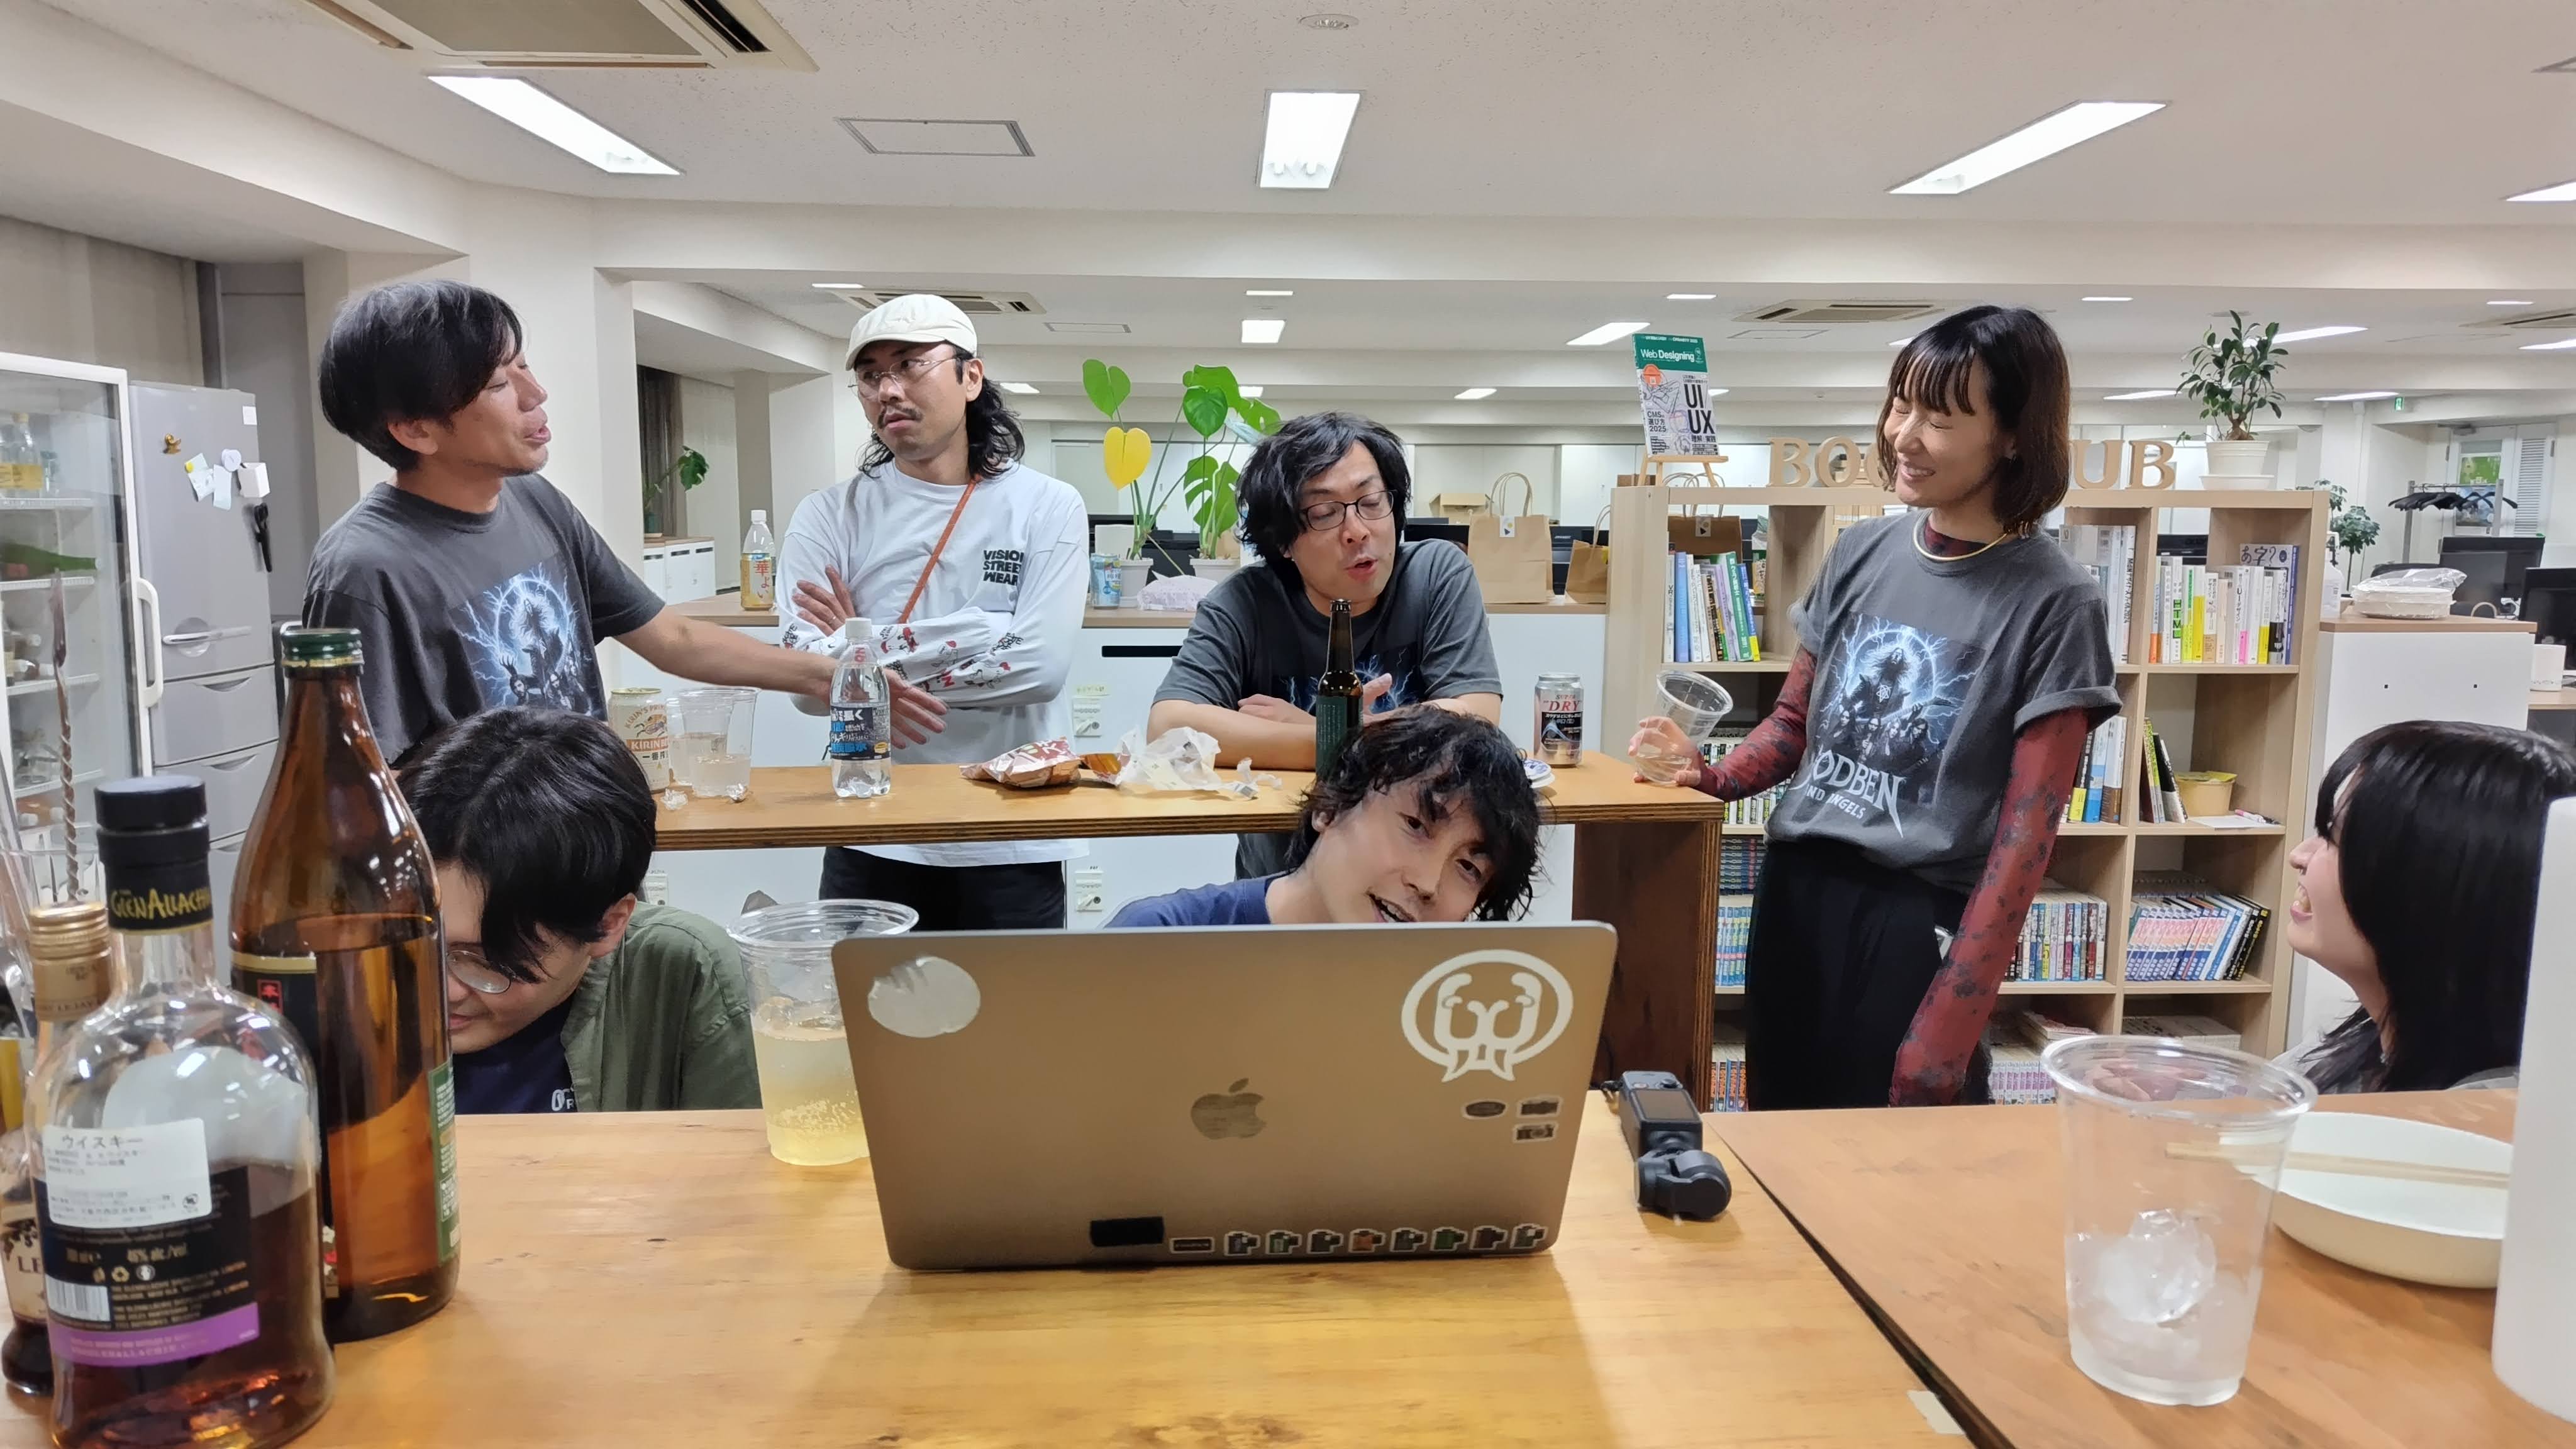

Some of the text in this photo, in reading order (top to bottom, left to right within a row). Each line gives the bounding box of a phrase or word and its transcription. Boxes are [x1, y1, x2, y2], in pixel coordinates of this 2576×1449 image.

[1641, 349, 1695, 362] Web Designing
[1687, 409, 1715, 434] UX
[2070, 439, 2175, 490] UB
[982, 560, 1022, 574] STREE
[2173, 599, 2182, 638] HTML
[631, 740, 662, 750] KIRIN
[1789, 746, 1907, 838] ODBEN
[62, 1135, 143, 1149] ウイスキー
